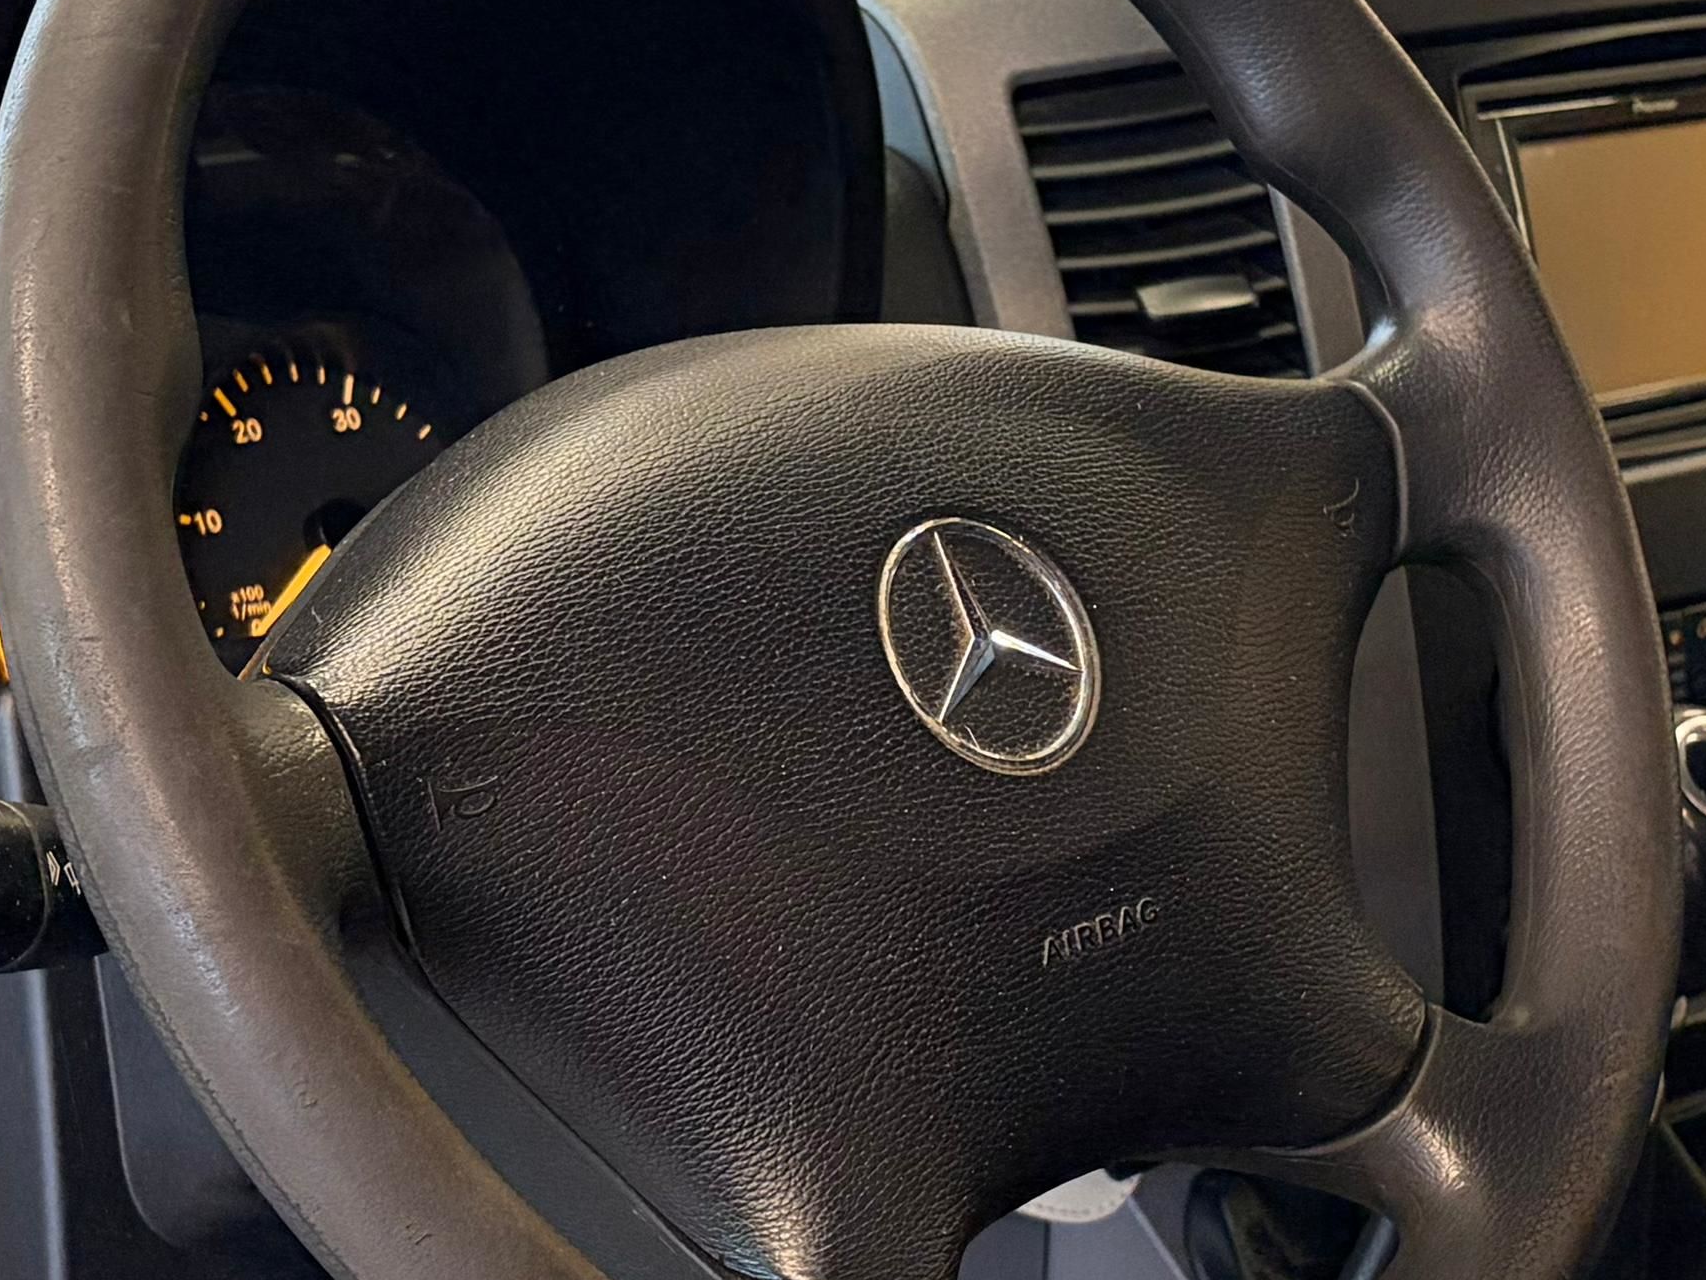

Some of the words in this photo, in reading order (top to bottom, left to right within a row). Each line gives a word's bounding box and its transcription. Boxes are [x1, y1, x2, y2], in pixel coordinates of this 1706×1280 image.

[231, 418, 263, 444] 20
[331, 407, 362, 433] 30
[195, 509, 223, 535] 10
[1043, 896, 1160, 968] AIRBAG
